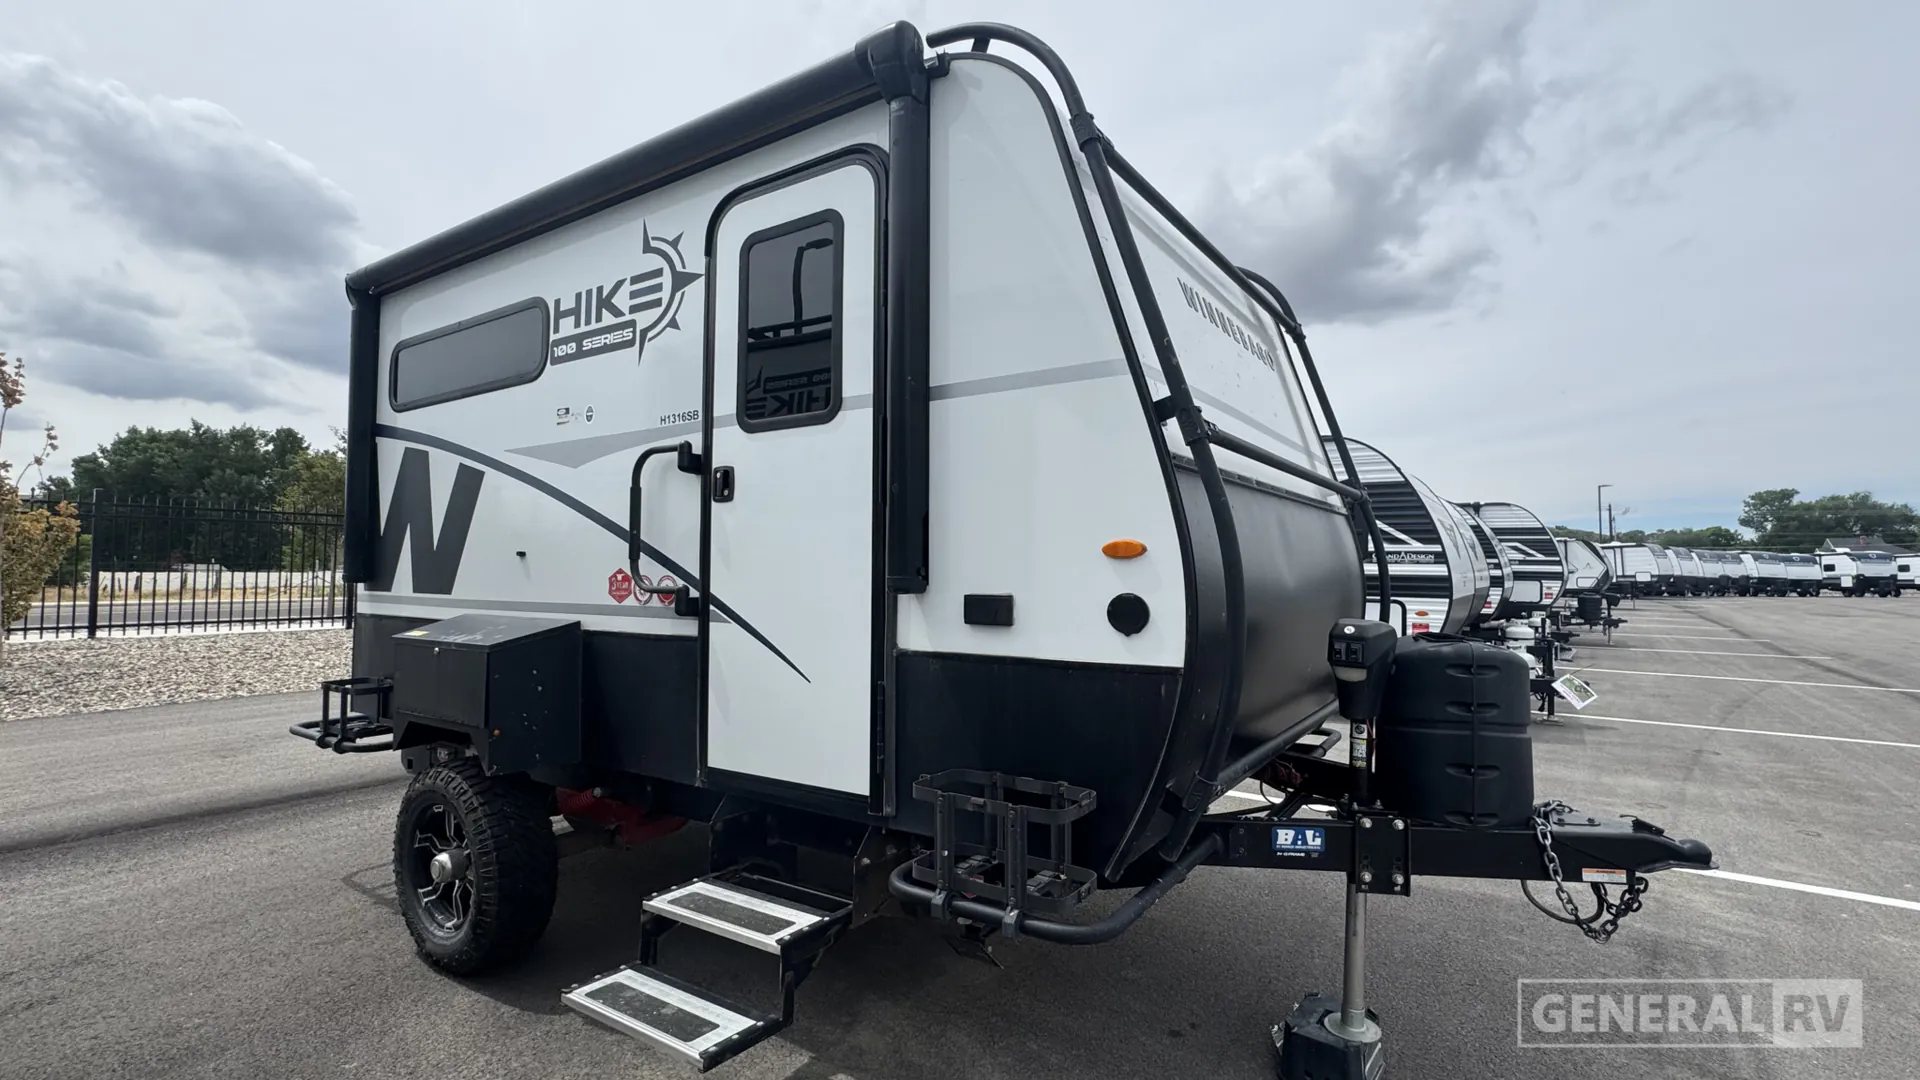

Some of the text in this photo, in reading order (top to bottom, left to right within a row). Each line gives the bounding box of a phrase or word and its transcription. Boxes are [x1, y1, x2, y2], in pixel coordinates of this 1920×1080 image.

[552, 267, 664, 335] HIKE
[1177, 277, 1275, 371] WINNEBAGO
[553, 327, 633, 357] 100 SERIES
[659, 409, 700, 426] H1316SB
[1276, 829, 1322, 846] BAL
